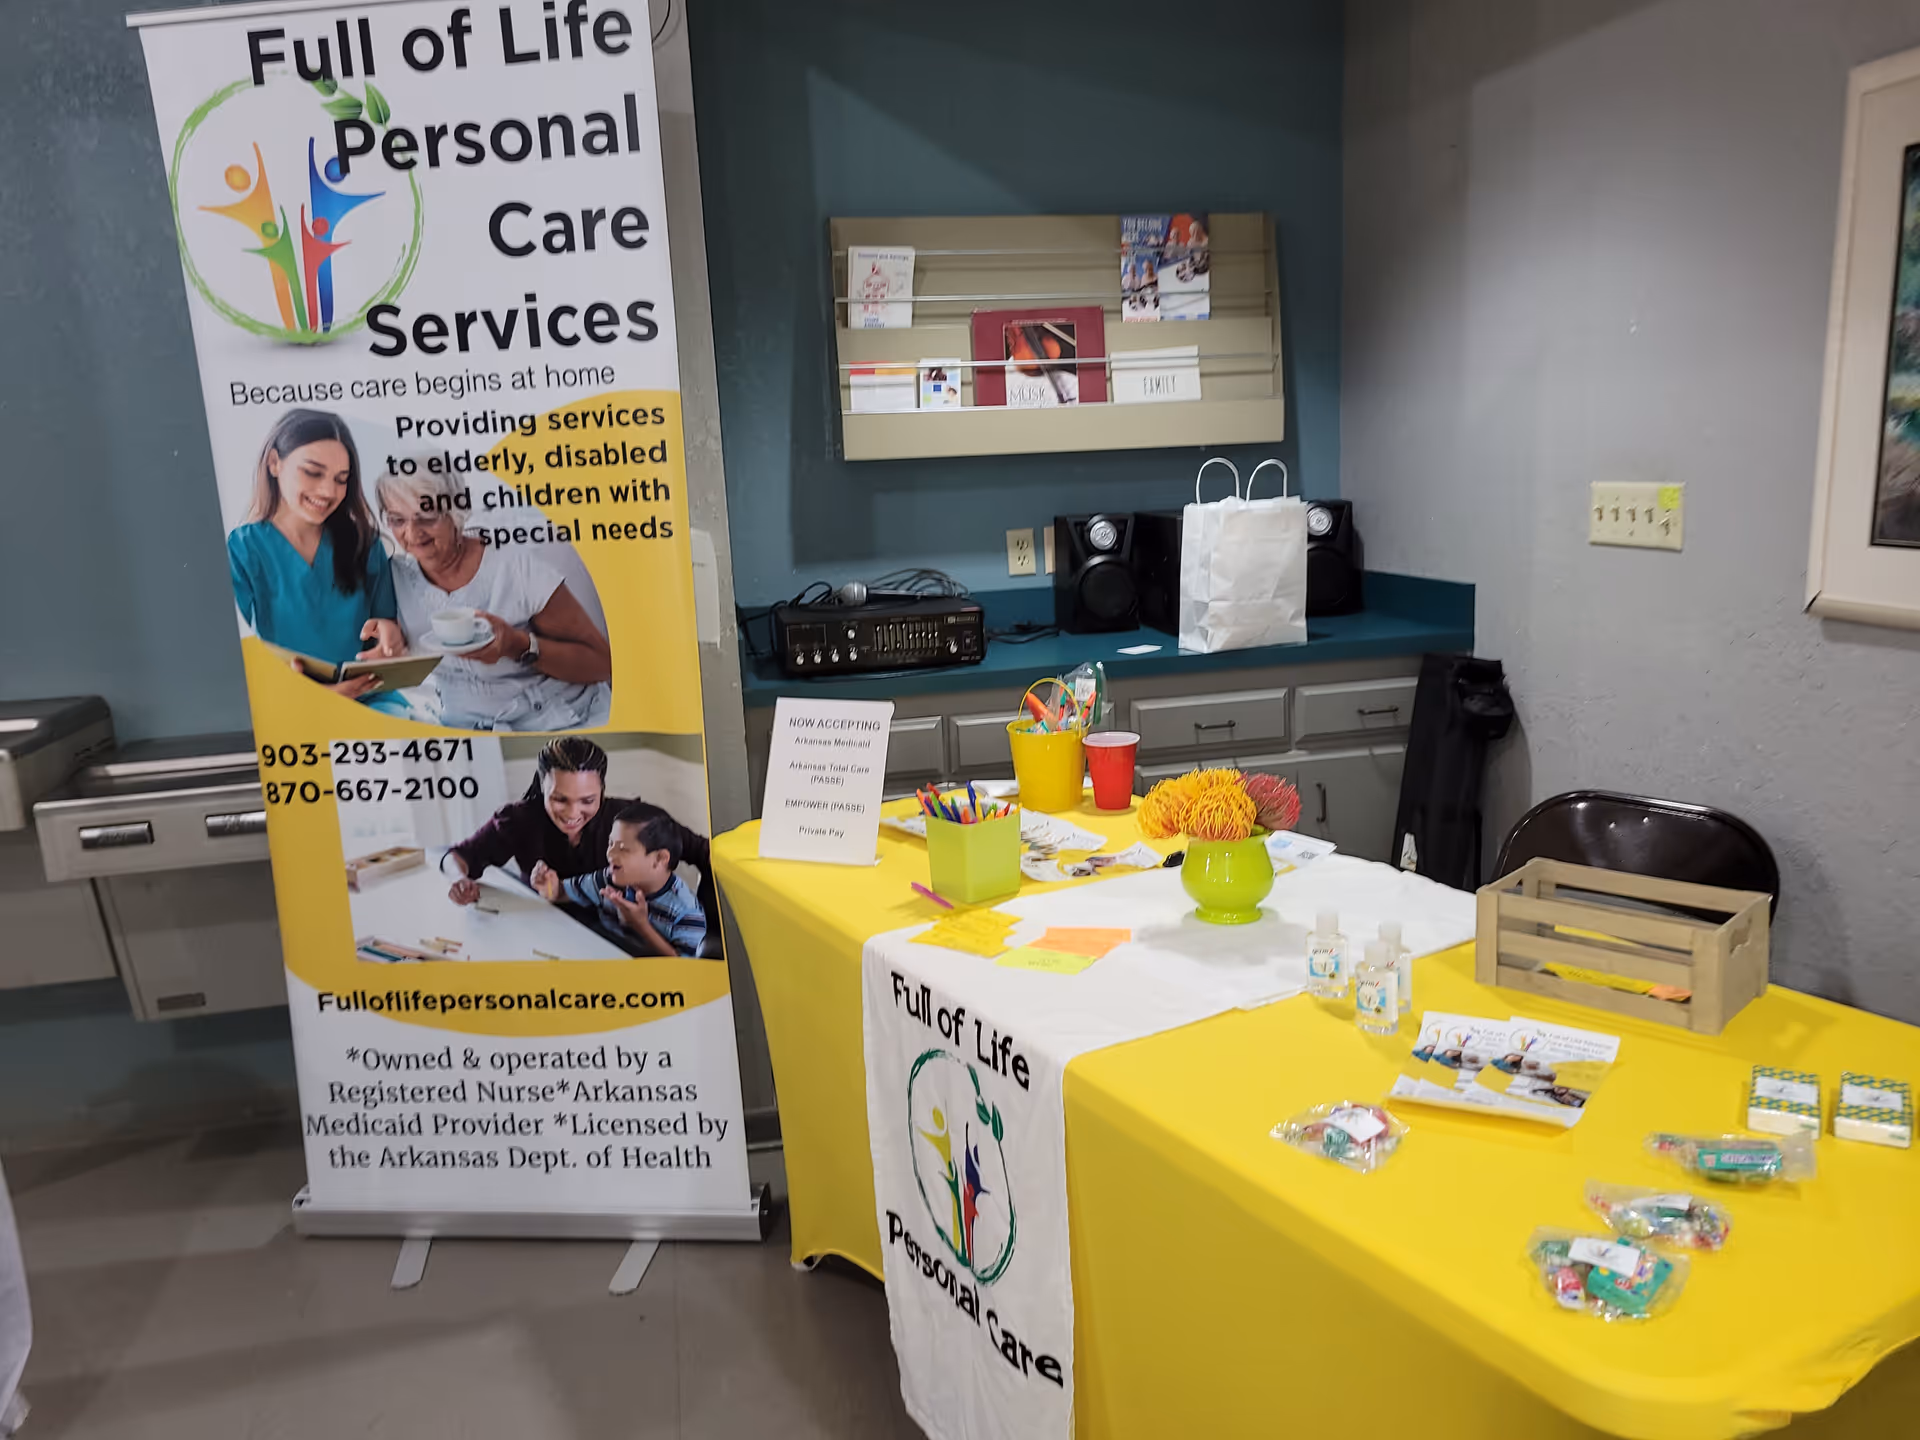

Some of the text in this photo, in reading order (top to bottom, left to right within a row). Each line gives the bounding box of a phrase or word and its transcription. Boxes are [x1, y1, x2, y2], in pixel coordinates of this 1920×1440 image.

[247, 0, 632, 85] Full of Life
[334, 93, 641, 174] Personal
[489, 202, 650, 257] Care
[366, 292, 659, 357] Services
[230, 362, 616, 406] Because care begins at home
[396, 403, 666, 439] Providing services
[386, 441, 668, 477] to elderly, disabled
[419, 478, 671, 514] and children with
[479, 516, 674, 551] special needs
[789, 717, 881, 732] NOW ACCEPTING
[261, 737, 474, 768] 903-293-4671
[794, 737, 871, 749] Arkansas Medicaid
[789, 761, 870, 775] Arkansas Total Care
[810, 775, 845, 787] (PASSE)
[265, 776, 479, 805] 870-667-2100
[785, 799, 865, 814] EMPOWER (PASSE)
[799, 825, 845, 839] Private Pay
[318, 989, 686, 1014] Fulloflifepersonalcare.com
[890, 971, 1031, 1092] Full of Life
[463, 1047, 480, 1069] &
[490, 1046, 606, 1075] operated
[615, 1045, 648, 1075] by
[657, 1052, 672, 1068] a
[329, 1080, 466, 1109] Registered
[305, 1113, 422, 1137] Medicaid
[433, 1113, 544, 1137] Provider
[698, 1111, 729, 1142] by
[329, 1145, 712, 1174] the Arkansas Dept. of Health
[885, 1208, 1065, 1389] Personal Care
